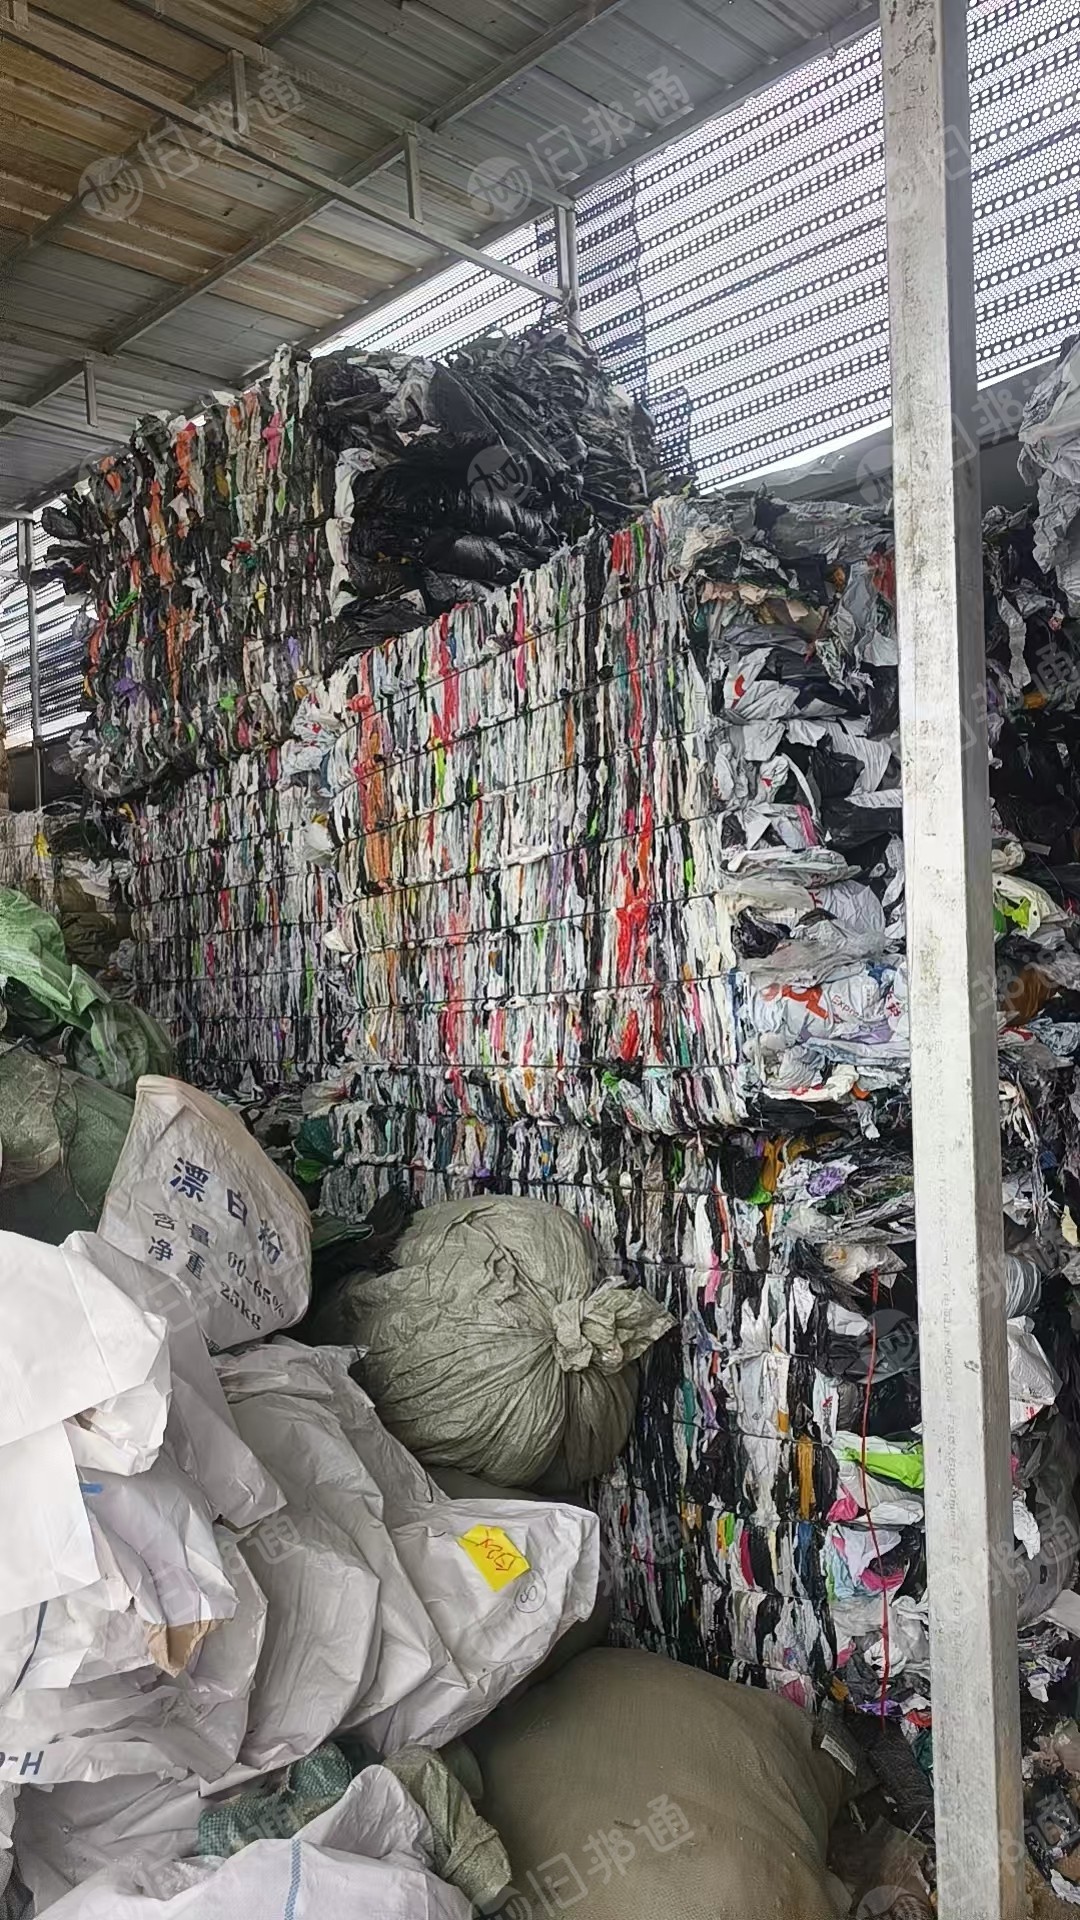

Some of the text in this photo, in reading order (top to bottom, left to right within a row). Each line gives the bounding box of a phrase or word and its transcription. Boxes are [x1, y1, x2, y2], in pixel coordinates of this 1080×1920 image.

[153, 1211, 211, 1249] 含量
[169, 1157, 284, 1265] 漂白粉
[148, 1236, 207, 1281] 净重
[219, 1281, 262, 1331] 25kg
